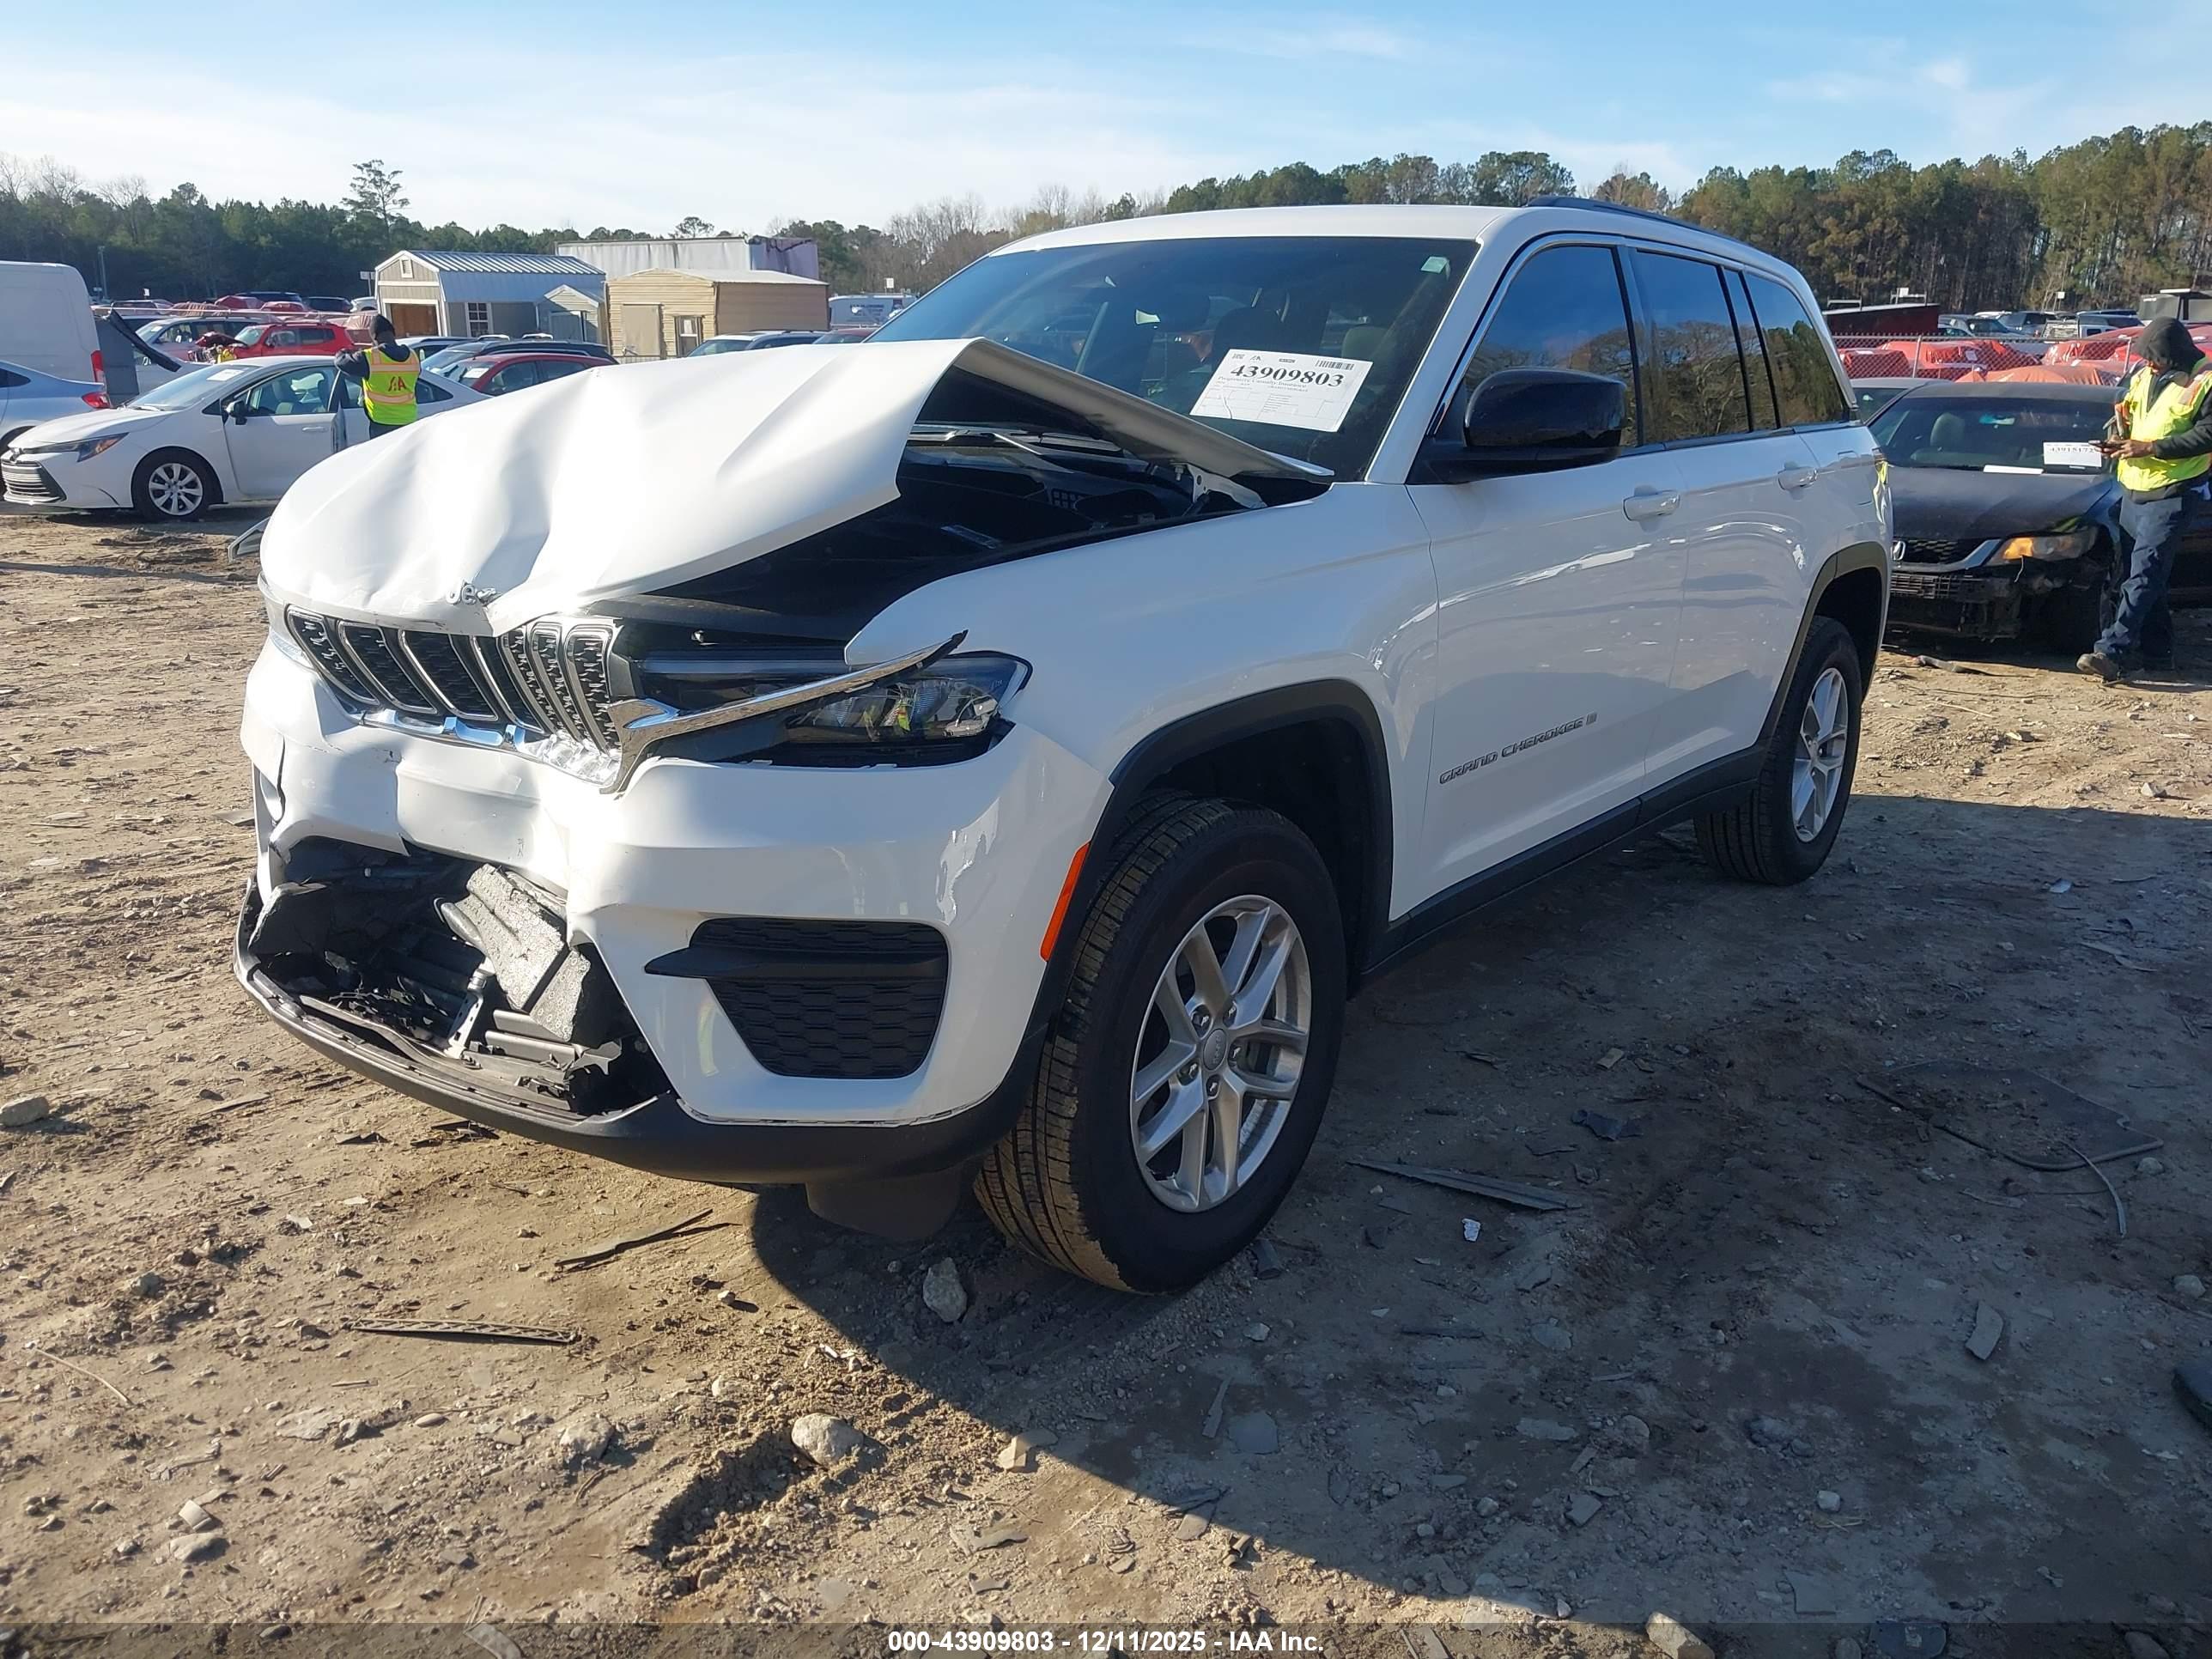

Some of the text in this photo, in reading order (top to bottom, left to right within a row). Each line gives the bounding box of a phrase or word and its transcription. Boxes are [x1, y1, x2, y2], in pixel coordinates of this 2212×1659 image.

[1231, 364, 1345, 387] 43909803
[1439, 716, 1585, 785] GRAND CHEROKEE
